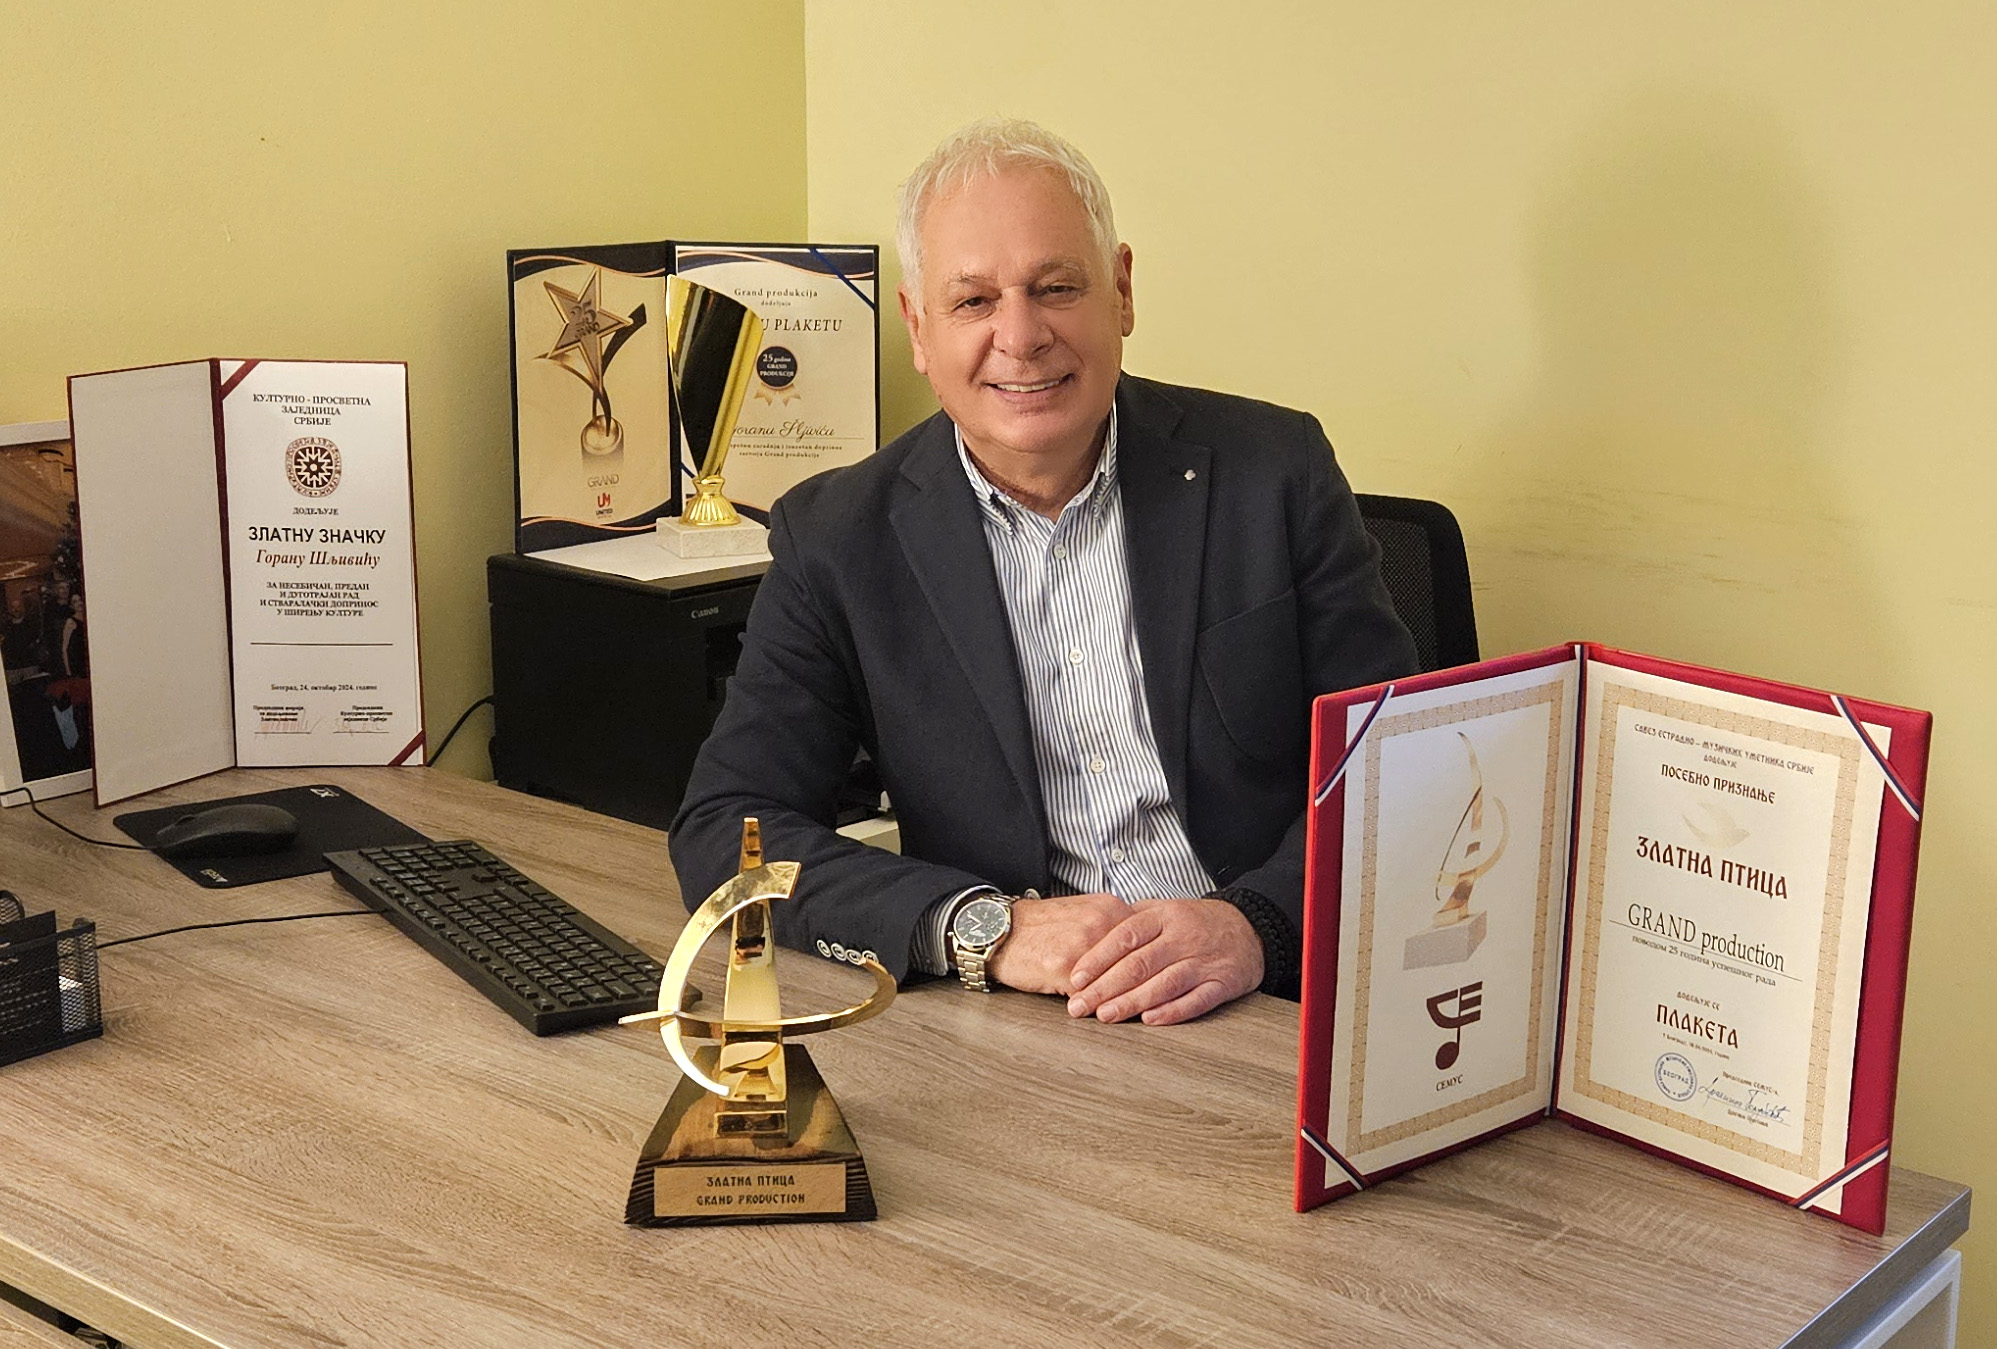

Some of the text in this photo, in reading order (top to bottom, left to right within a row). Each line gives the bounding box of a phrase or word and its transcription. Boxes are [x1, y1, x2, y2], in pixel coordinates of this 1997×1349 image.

[734, 288, 818, 299] Grand produkcija
[774, 319, 843, 332] PLAKETU
[762, 353, 774, 362] 25
[253, 393, 305, 404] КУЛТУРНО
[313, 395, 371, 406] ПРОСВЕТНА
[282, 405, 341, 416] ЗАЈЕДНИЦА
[294, 416, 331, 426] СРБИЈЕ
[588, 474, 619, 488] GRAND
[293, 507, 339, 516] ДОДЕЉУЈЕ
[248, 526, 386, 544] ЗЛАТНУ ЗНАЧКУ
[256, 549, 380, 569] Горану Шљивићу
[266, 581, 277, 589] ЗА
[335, 583, 370, 591] ПРЕДАН
[343, 592, 360, 600] РАД
[691, 606, 719, 619] Canon
[1634, 723, 1656, 737] САВЕЗ
[1658, 730, 1695, 746] ЕСТРАДНО
[1744, 751, 1785, 768] УМЕТНИКА
[1786, 761, 1815, 775] СРБИЈЕ
[1661, 764, 1776, 805] ПОСЕБНО ПРИЗНАЊЕ
[1636, 835, 1788, 899] ЗЛАТНА ПТИЦА
[1628, 903, 1785, 972] GRAND production
[1632, 936, 1667, 952] поводом
[1668, 945, 1679, 955] 25
[1680, 950, 1710, 965] година
[1755, 974, 1776, 986] рада
[1656, 1003, 1738, 1049] ПЛАКЕТА
[1436, 1074, 1464, 1091] СЕМУС
[706, 1175, 795, 1188] ЗЛАТНА ПТИЦА
[697, 1193, 805, 1206] GRAND PRODUCTION
